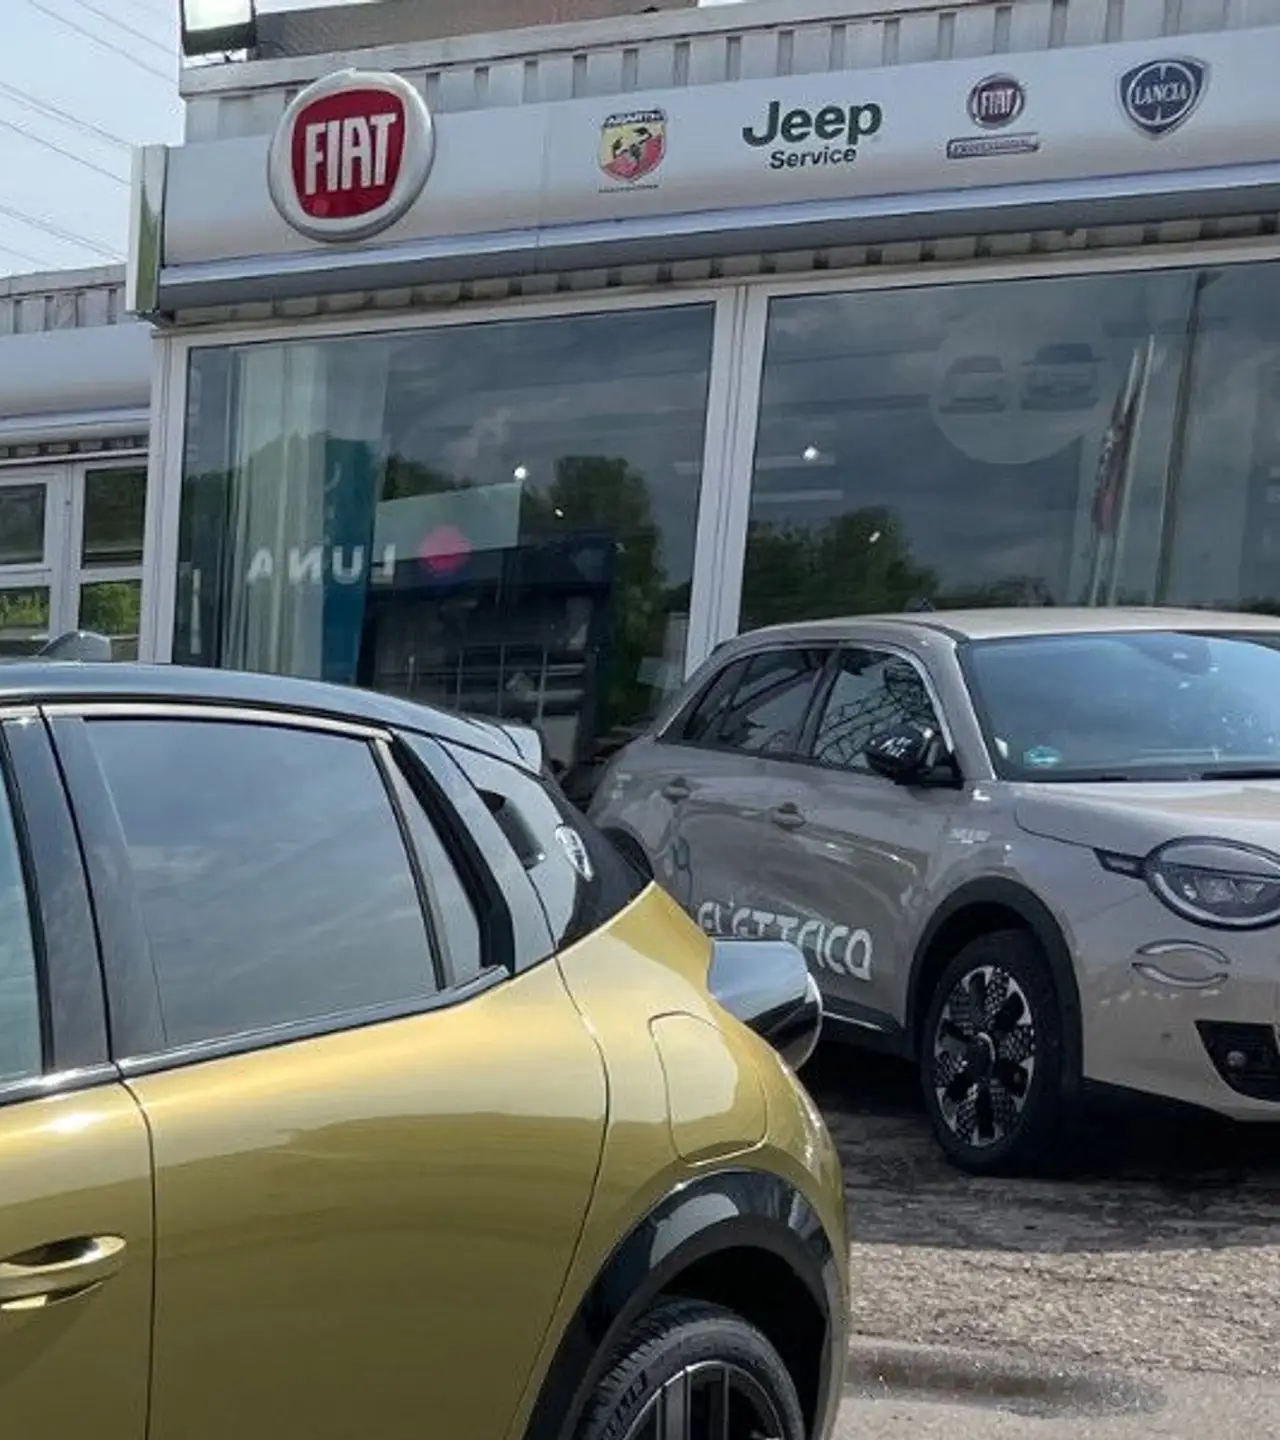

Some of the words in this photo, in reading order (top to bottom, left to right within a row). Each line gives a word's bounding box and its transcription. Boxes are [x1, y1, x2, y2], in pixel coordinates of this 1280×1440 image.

[981, 88, 1015, 116] FIAT
[1134, 83, 1187, 105] LANCIA
[742, 101, 883, 147] Jeep
[304, 112, 398, 196] FIAT
[769, 146, 858, 170] Service
